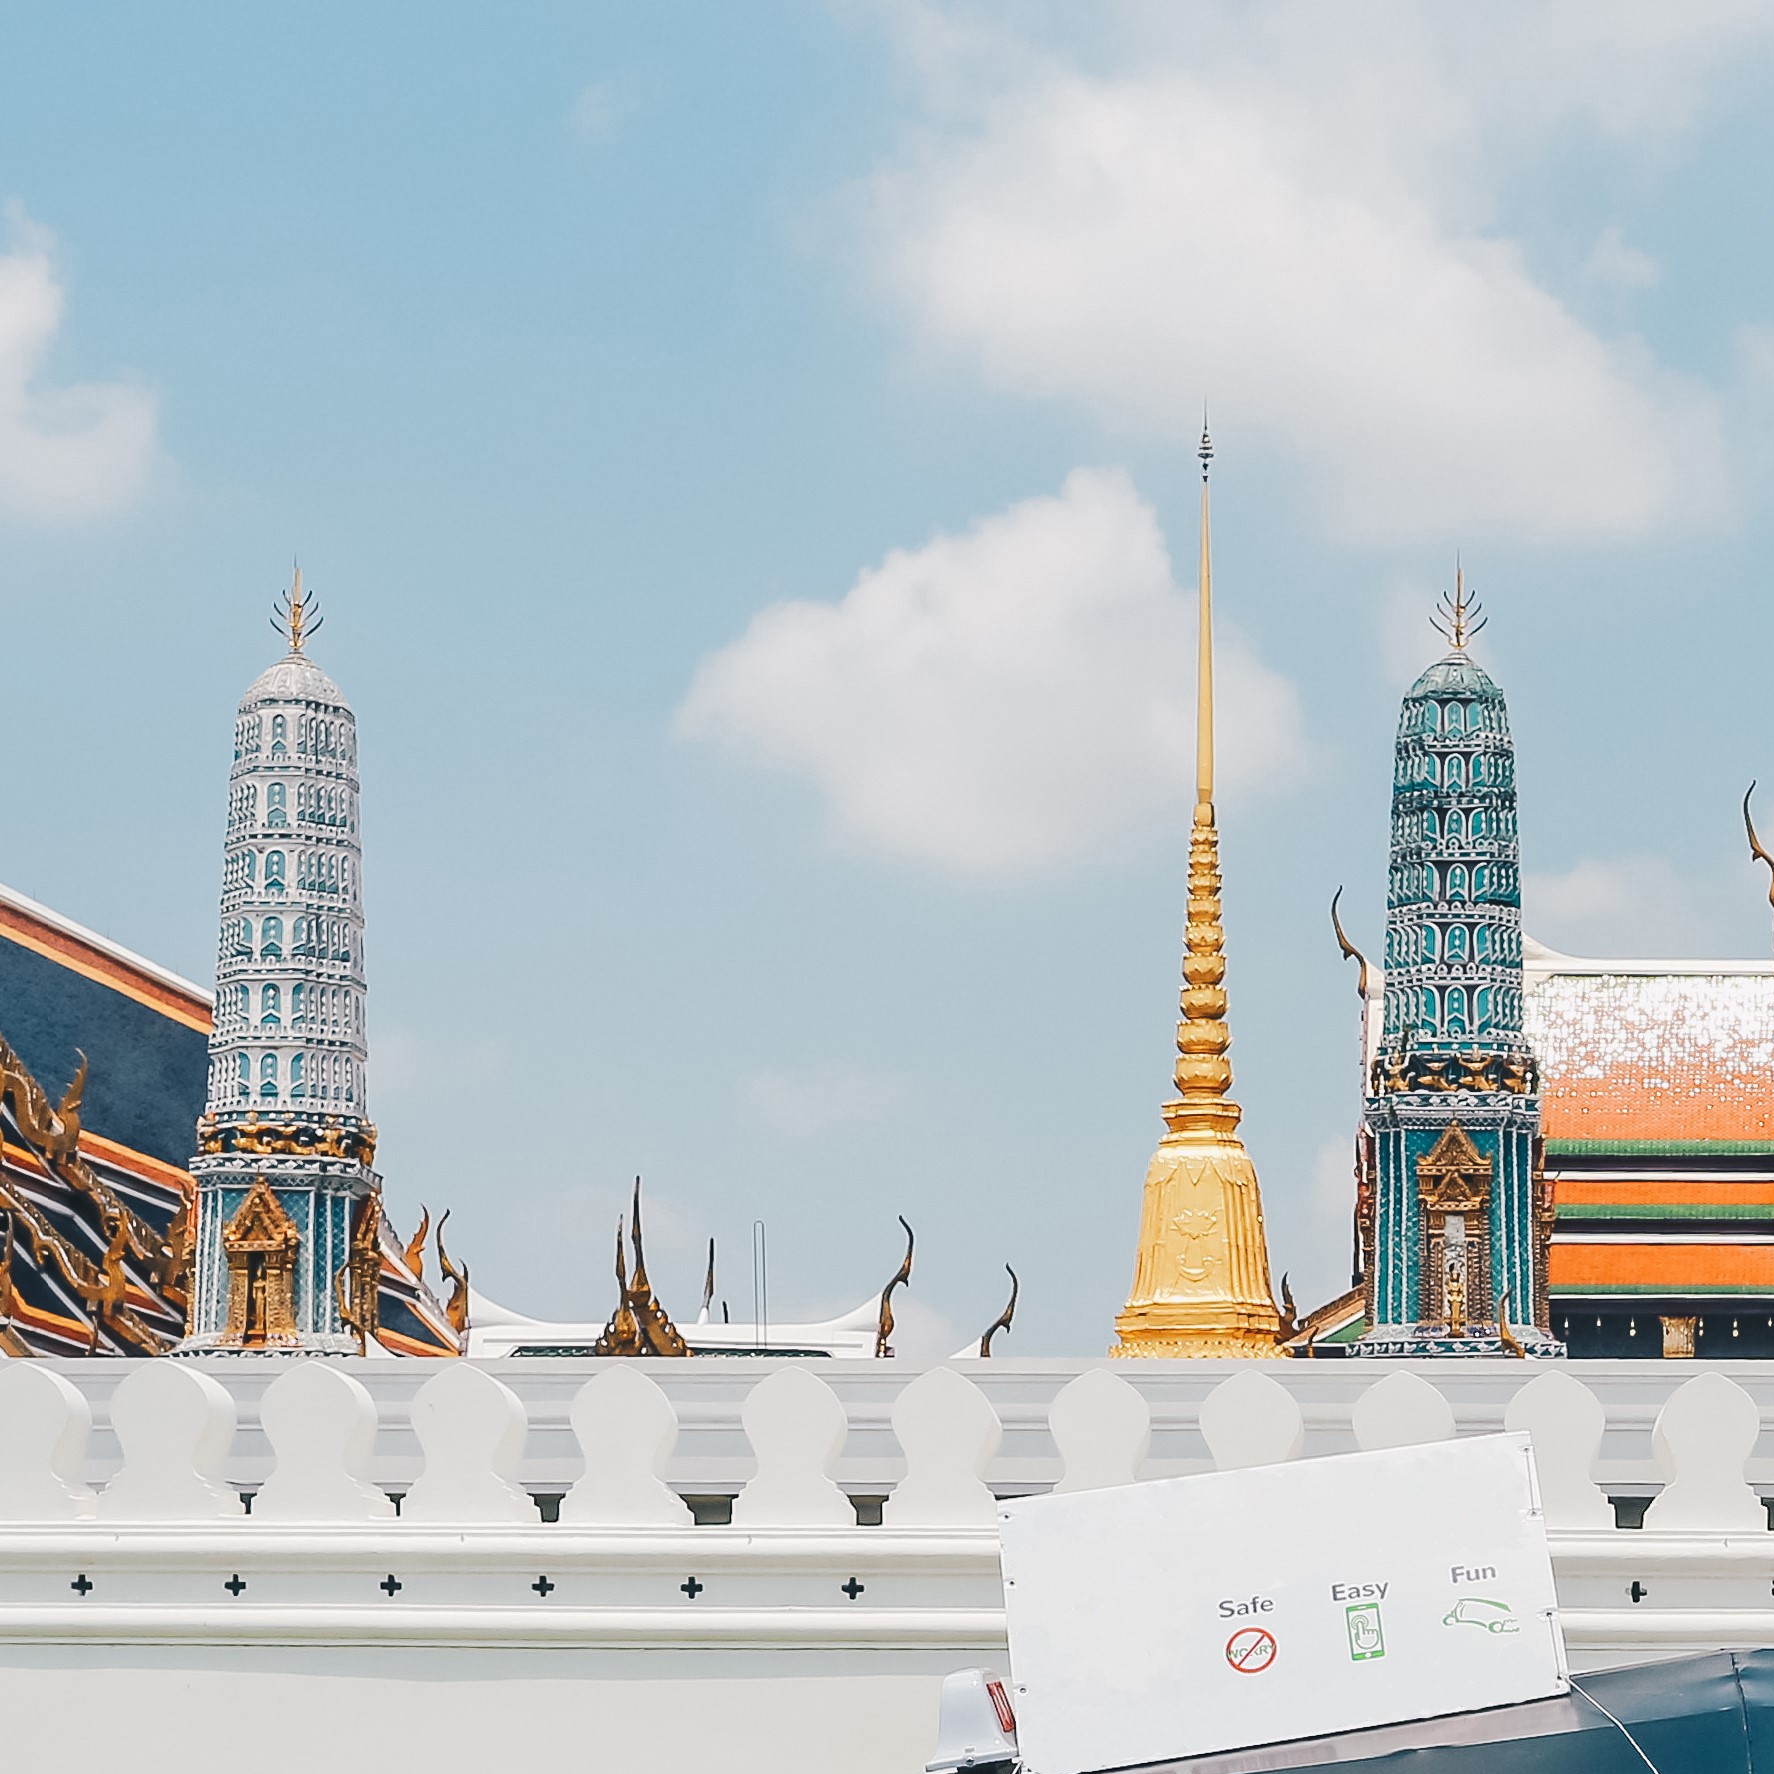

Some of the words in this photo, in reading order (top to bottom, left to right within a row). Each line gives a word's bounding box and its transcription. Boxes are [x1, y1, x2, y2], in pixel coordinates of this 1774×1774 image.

[1450, 1565, 1497, 1584] Fun
[1331, 1581, 1390, 1601] Easy
[1218, 1595, 1274, 1618] Safe
